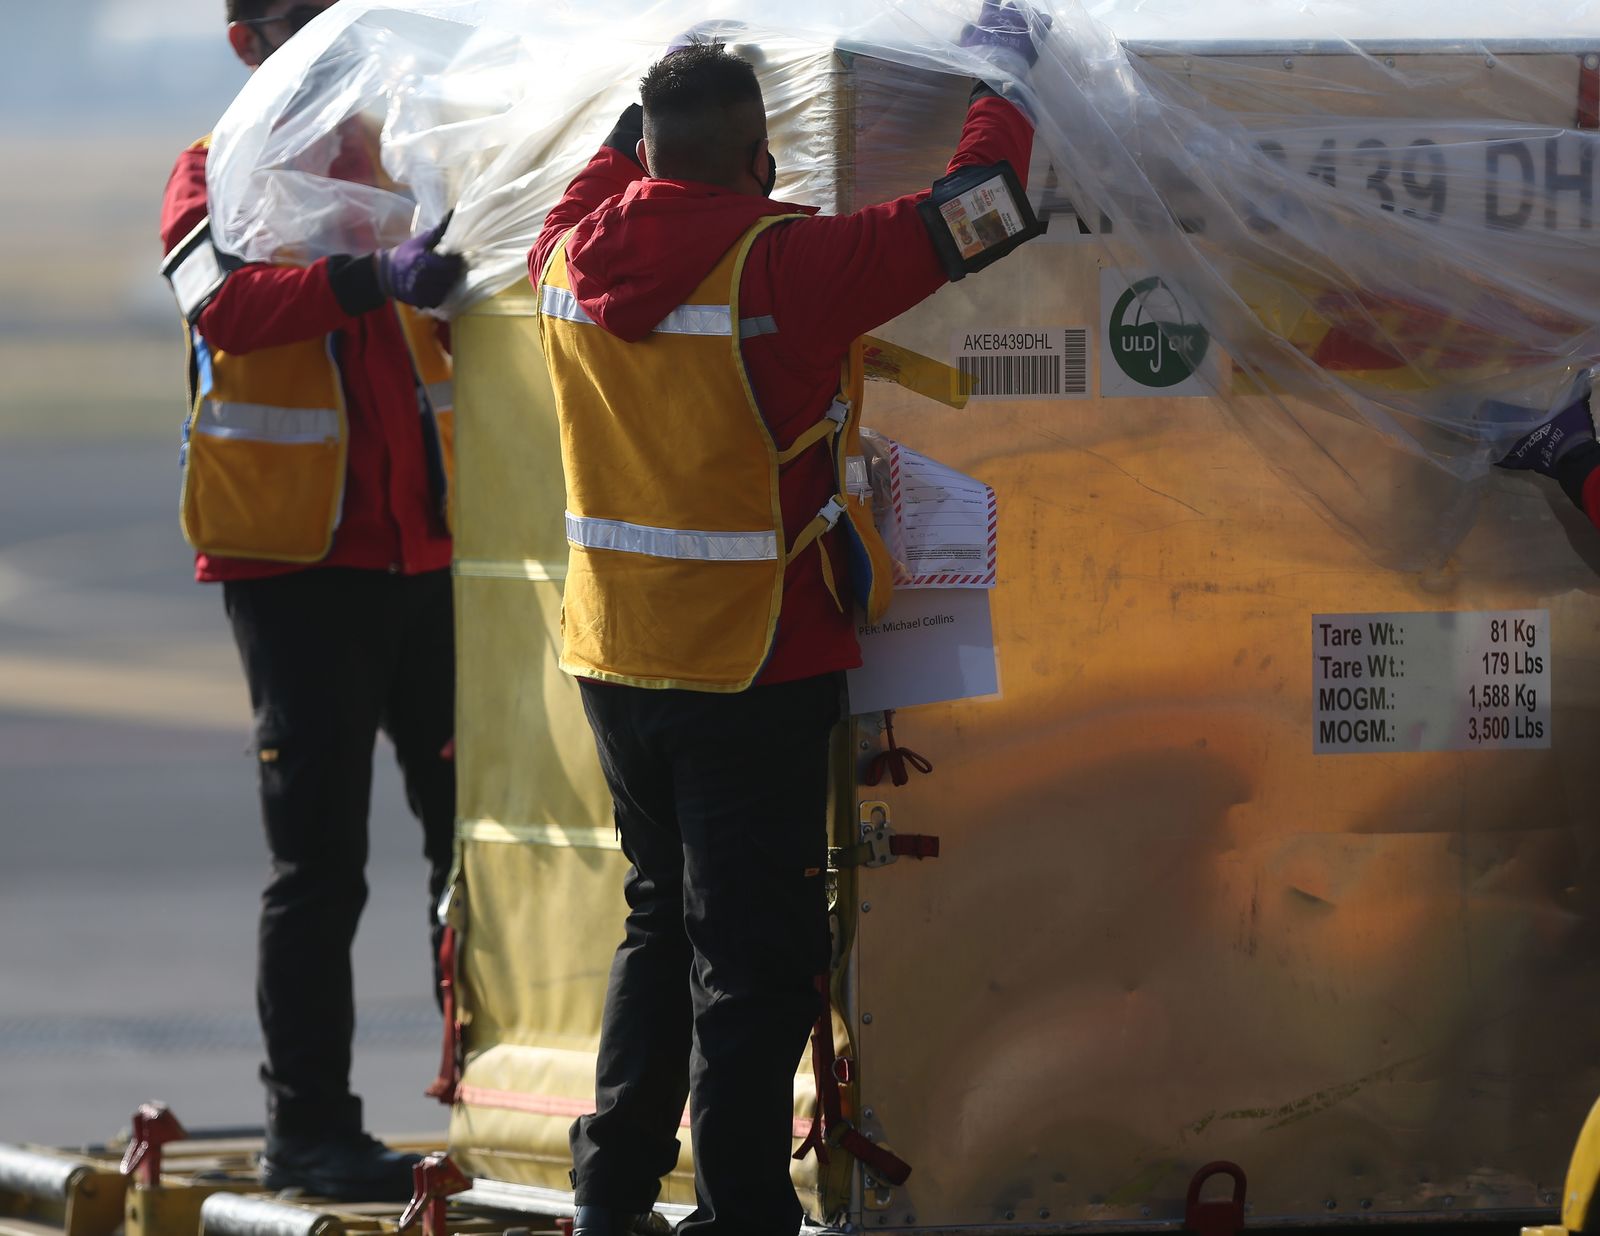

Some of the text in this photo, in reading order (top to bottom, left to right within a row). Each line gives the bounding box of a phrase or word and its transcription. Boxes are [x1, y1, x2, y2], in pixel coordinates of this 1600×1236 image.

[964, 333, 1052, 350] AKE8439DHL
[1121, 335, 1194, 352] ULD OK
[882, 617, 921, 632] Michael
[923, 614, 954, 627] Collins
[1319, 619, 1536, 648] Tare Wt.: 81 Kg
[1319, 651, 1544, 679] Tare Wt.: 179 Lbs
[1319, 683, 1537, 712] MOGM.: 1,588 Kg
[1319, 716, 1544, 744] MOGM.: 3,500 Lbs
